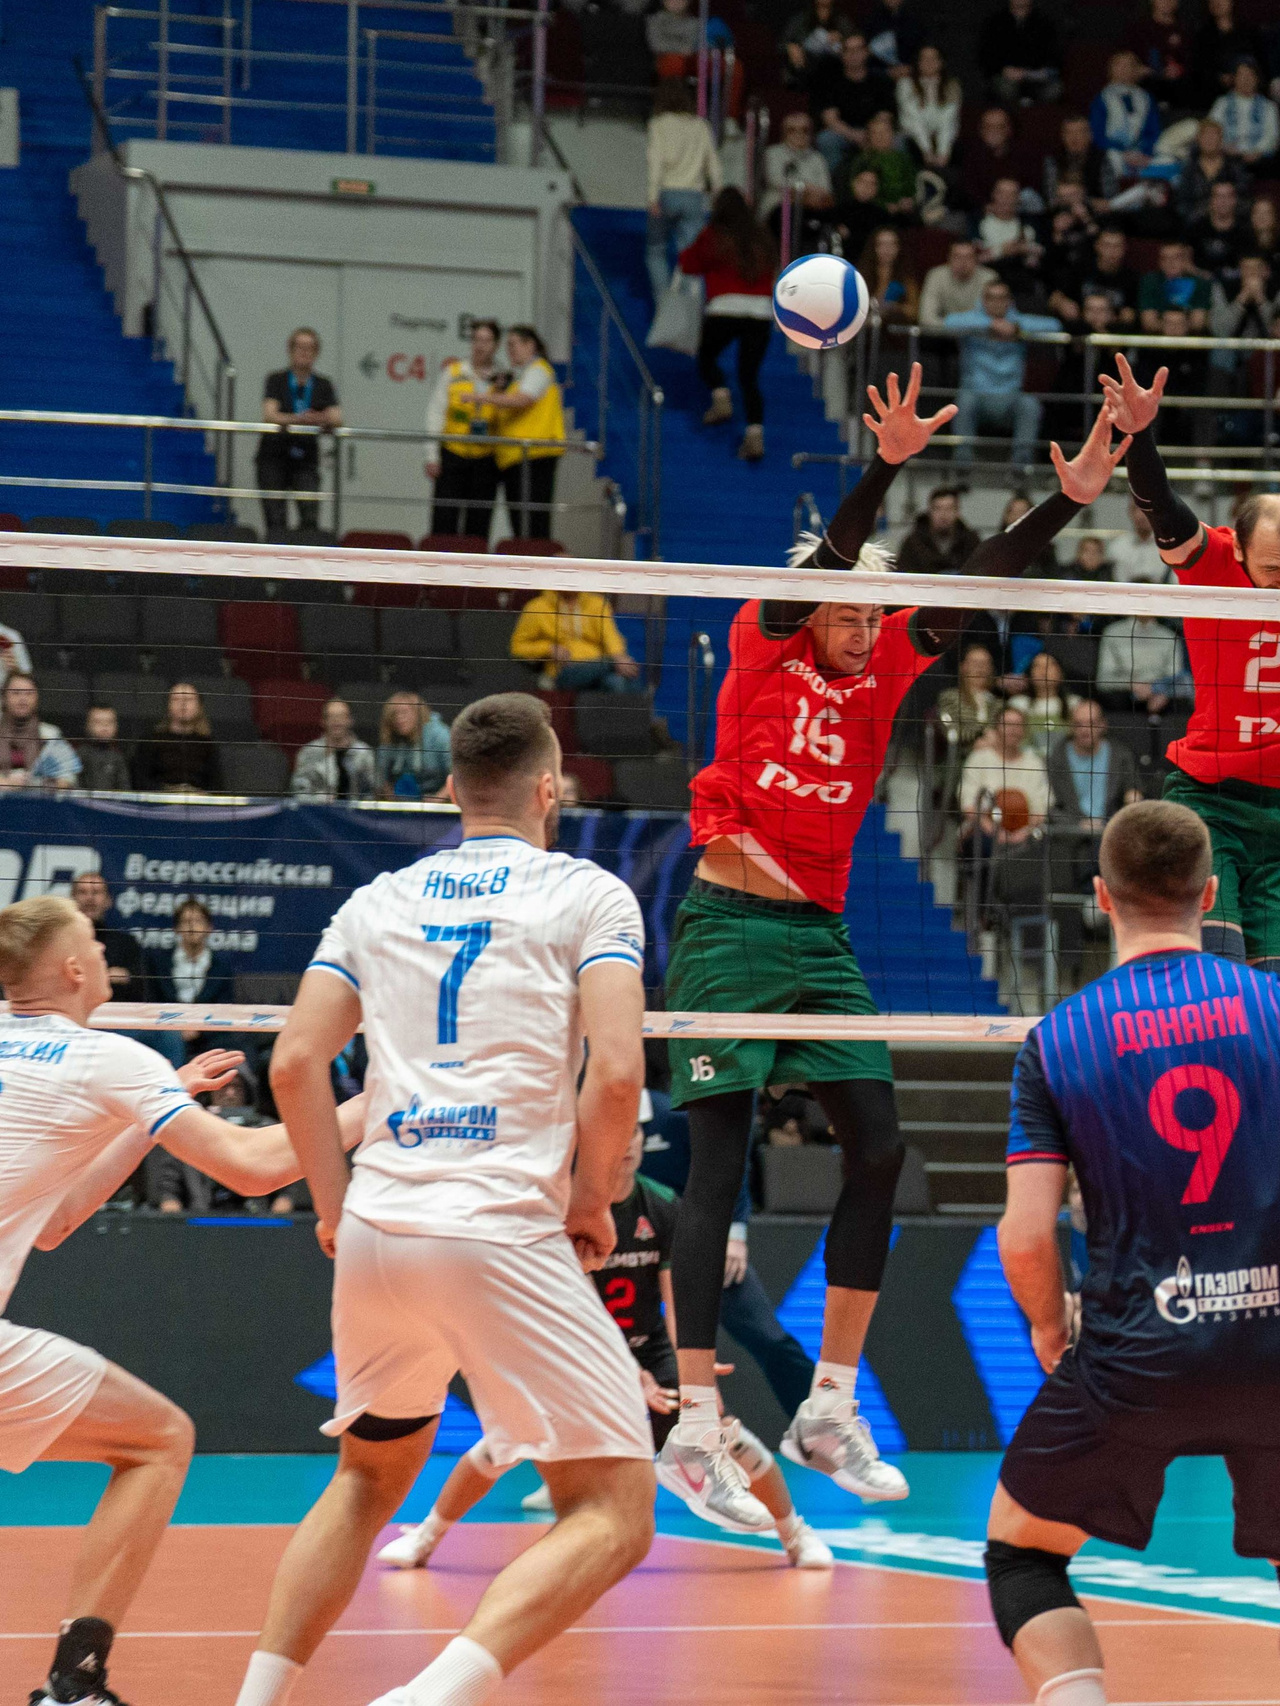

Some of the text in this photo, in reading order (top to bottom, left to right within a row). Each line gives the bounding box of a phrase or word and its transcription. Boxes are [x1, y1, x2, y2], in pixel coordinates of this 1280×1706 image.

[789, 696, 846, 766] 16
[124, 853, 333, 887] Всероссийская
[422, 866, 510, 899] АБАЕВ
[420, 920, 493, 1045] 7
[1112, 995, 1249, 1058] ДАНАНИ
[689, 1055, 716, 1082] 16
[420, 1105, 497, 1126] ГАЗПРОМ
[1148, 1064, 1241, 1204] 9
[1194, 1264, 1279, 1298] ГАЗПРОМ
[605, 1277, 637, 1328] 2
[1199, 1291, 1279, 1310] ТРАНСГАЗ
